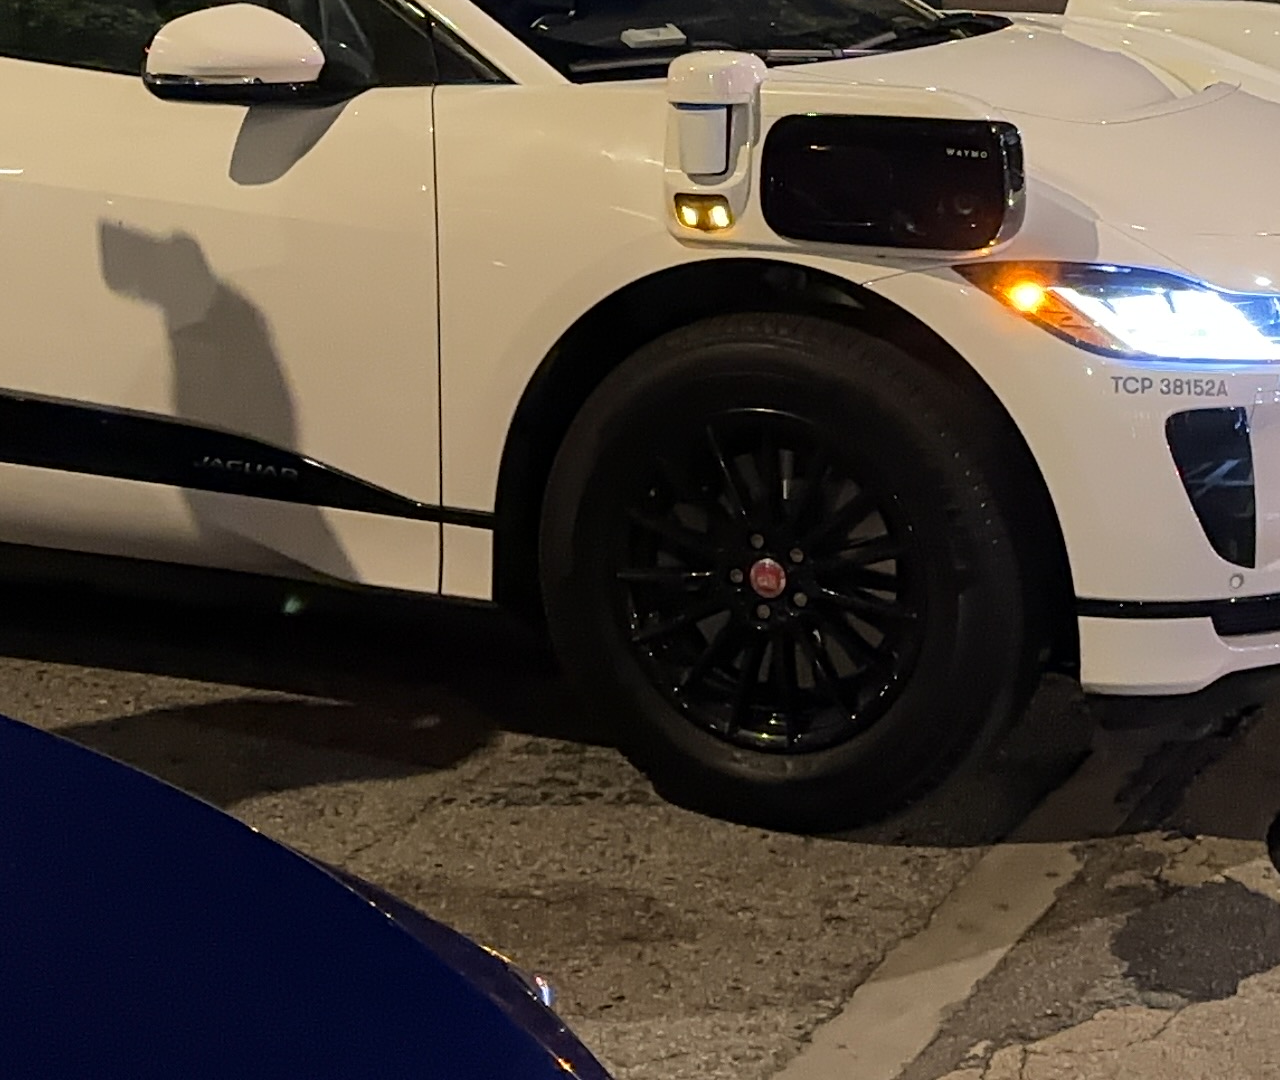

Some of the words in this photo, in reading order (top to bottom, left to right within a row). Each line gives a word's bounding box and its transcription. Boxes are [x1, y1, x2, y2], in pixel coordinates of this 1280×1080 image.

[946, 147, 988, 159] WAYMO
[1110, 376, 1153, 395] TCP
[1160, 378, 1228, 397] 38152A
